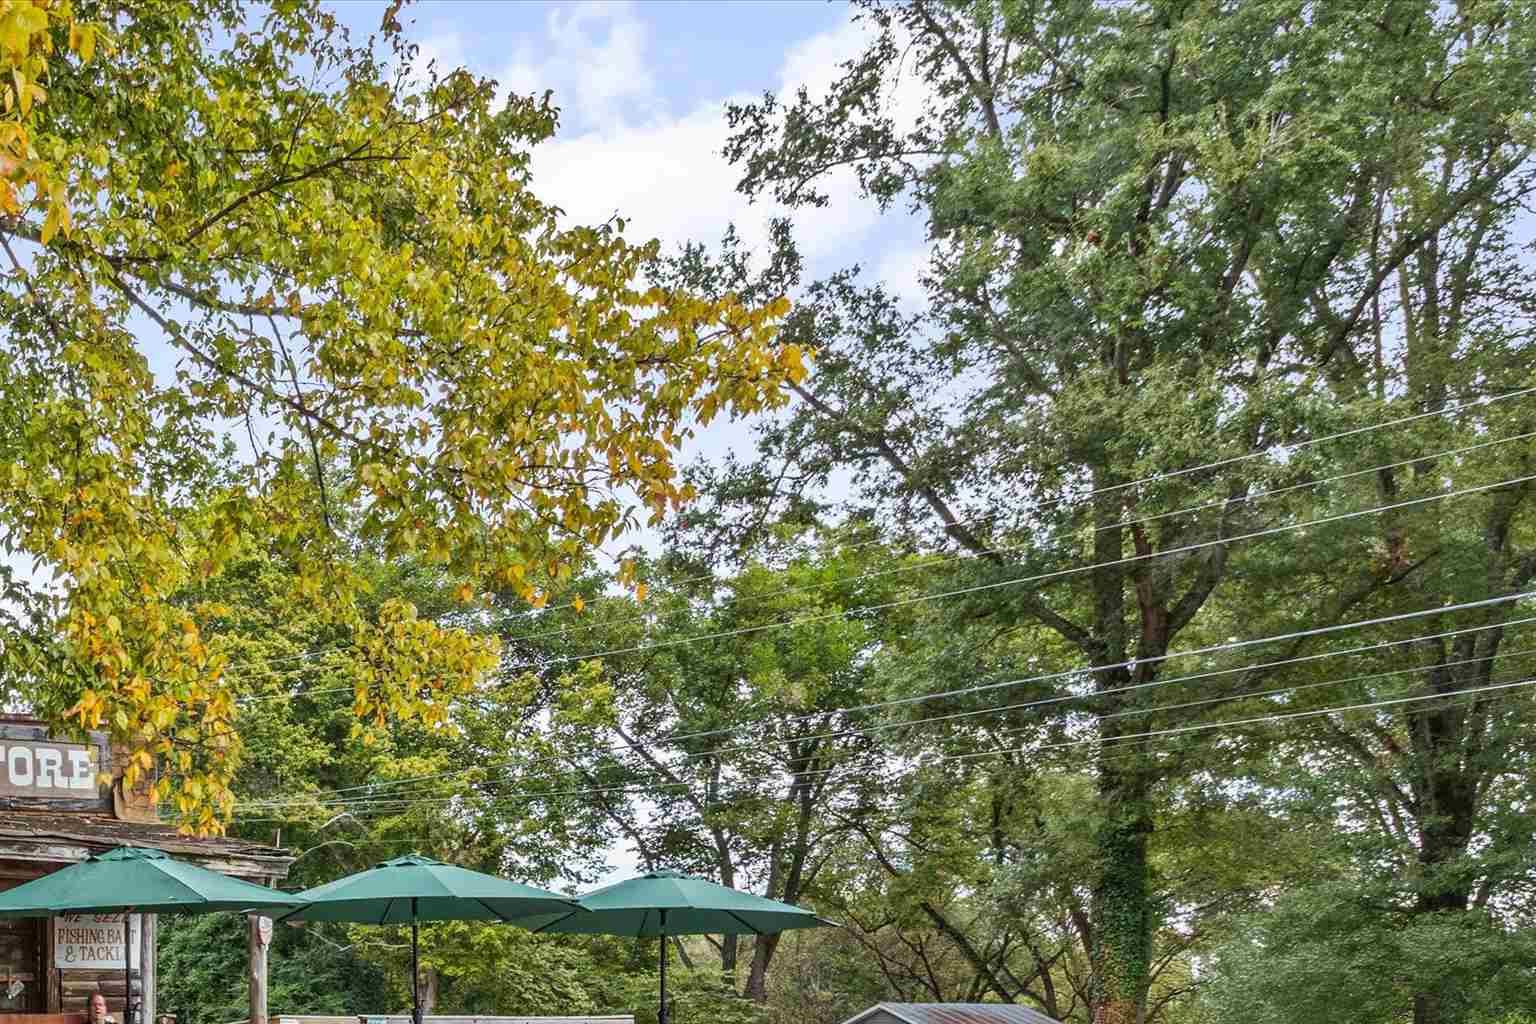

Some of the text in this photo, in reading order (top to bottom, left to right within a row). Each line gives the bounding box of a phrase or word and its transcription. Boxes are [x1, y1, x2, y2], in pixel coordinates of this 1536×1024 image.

[56, 928, 136, 944] FISHING BAT
[65, 946, 77, 962] &
